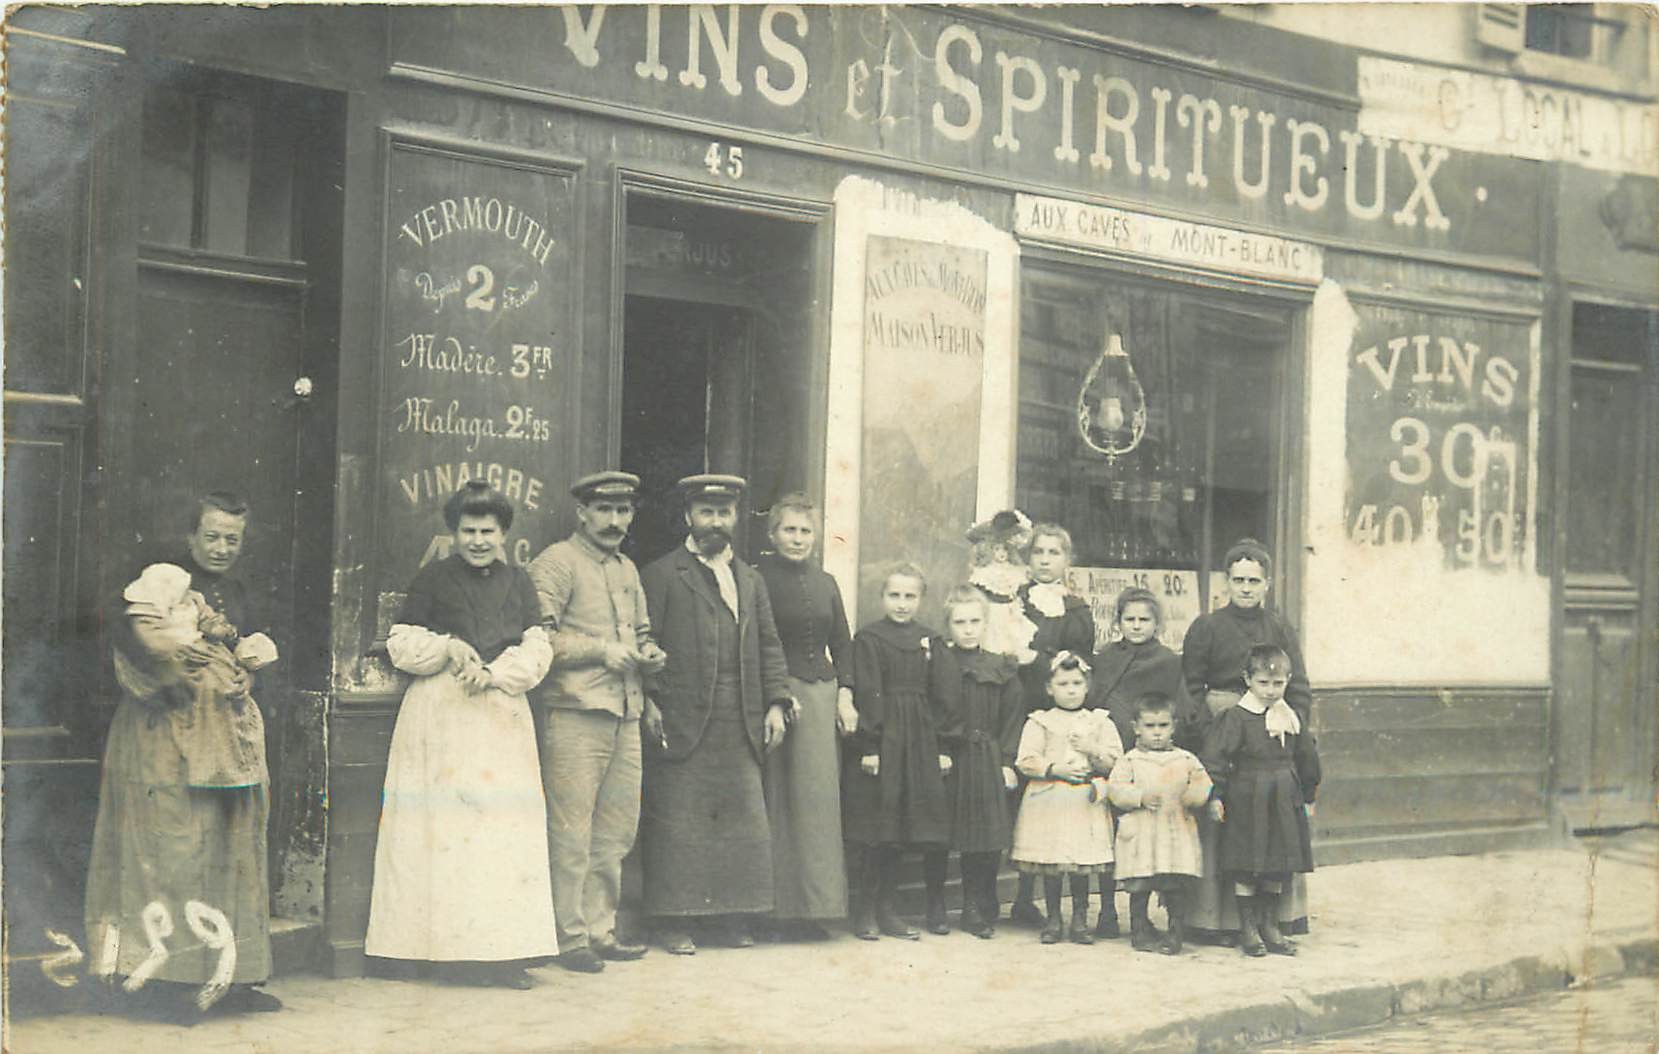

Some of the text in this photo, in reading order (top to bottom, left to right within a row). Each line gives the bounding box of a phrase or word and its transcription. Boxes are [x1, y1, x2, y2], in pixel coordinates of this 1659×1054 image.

[562, 5, 810, 106] VINS
[932, 25, 1452, 230] SPIRITUEUX
[704, 142, 743, 180] 45
[401, 196, 555, 266] VERMOUTH
[1031, 202, 1067, 232] AUX
[1077, 209, 1131, 242] CAVES
[1171, 228, 1301, 270] MONT-BLANC
[464, 263, 497, 312] 2
[1356, 335, 1519, 406] VINS
[400, 461, 544, 510] VINAIGRE
